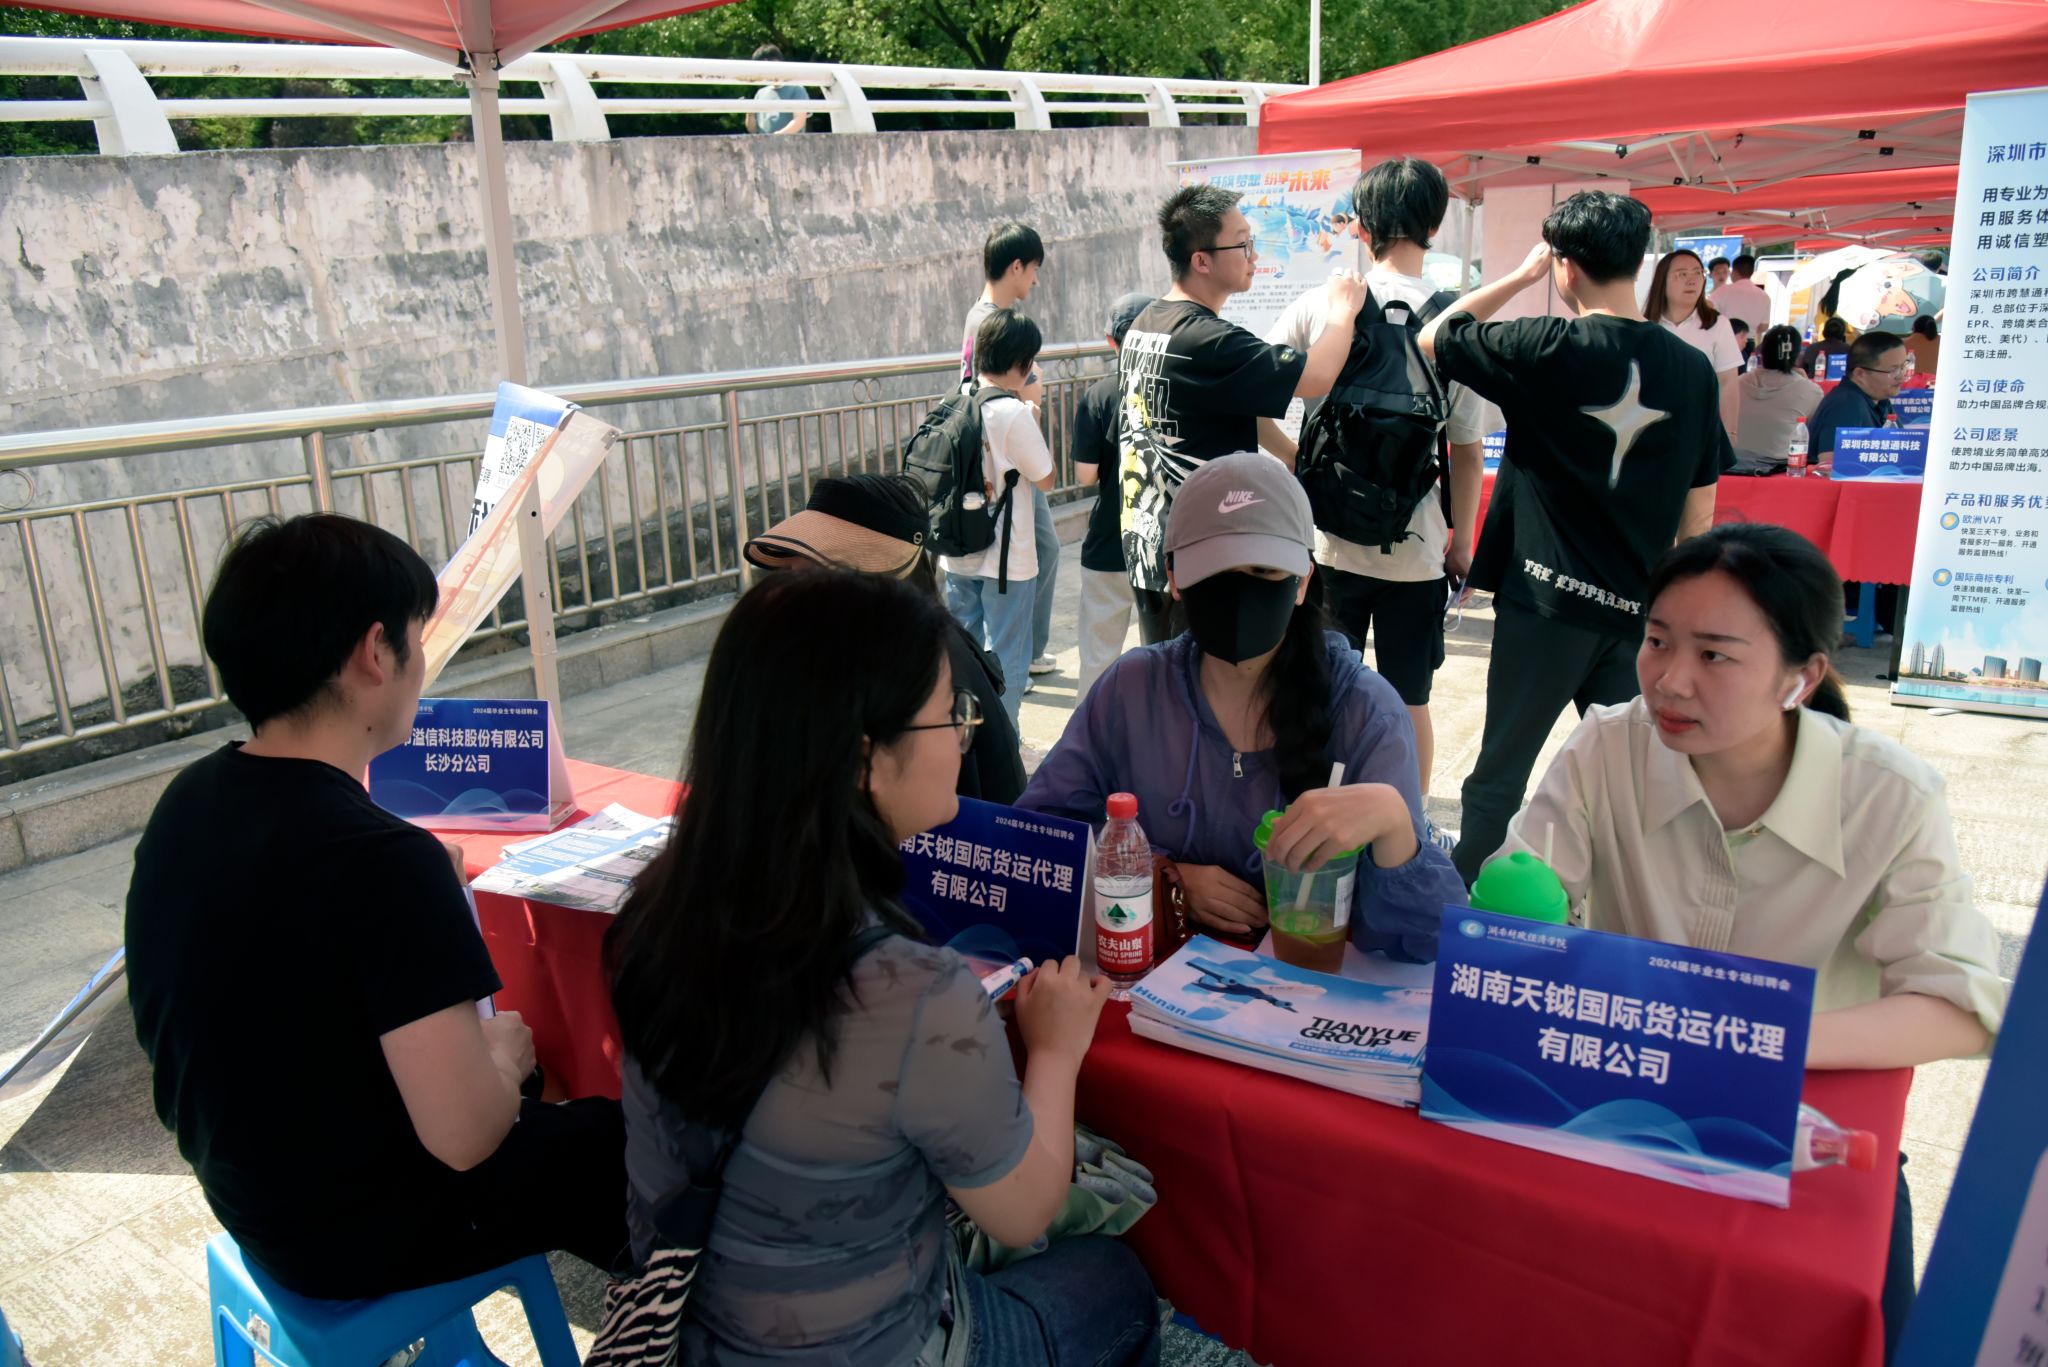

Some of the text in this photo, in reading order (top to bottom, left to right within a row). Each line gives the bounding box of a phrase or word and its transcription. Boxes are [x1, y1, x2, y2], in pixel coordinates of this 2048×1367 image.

[1986, 142, 2048, 164] 深圳市
[1983, 184, 2048, 203] 用专业为
[1980, 208, 2048, 226] 用服务体
[1977, 232, 2048, 250] 用诚信塑
[1972, 265, 2040, 281] 公司简介
[1964, 334, 2048, 344] 欧代、美代）、
[1963, 349, 2012, 359] 工商注册。
[1959, 379, 2025, 394] 公司使命
[1957, 399, 2048, 409] 助力中国品牌合规
[1953, 427, 2018, 442] 公司愿景
[1841, 439, 1920, 451] 深圳市跨慧通科技
[1859, 452, 1899, 463] 有限公司
[1949, 461, 2042, 473] 助力中国品牌出海。
[1225, 490, 1254, 503] NIKE
[1963, 514, 2003, 525] 欧洲VAT
[1955, 572, 2014, 584] 国际商标专利
[425, 753, 490, 773] 长沙分公司
[995, 816, 1075, 841] 2024届毕业生专场招聘会
[931, 870, 1007, 912] 有限公司
[1098, 935, 1143, 951] 农夫山泉
[1649, 956, 1791, 992] 2024届毕业生专场招聘会
[1133, 984, 1187, 1016] Hunan
[1450, 963, 1786, 1061] 湖南天钺国际货运代理
[1300, 1027, 1391, 1048] GROUP
[1311, 1016, 1421, 1042] TIANYUE
[1538, 1027, 1671, 1085] 有限公司
